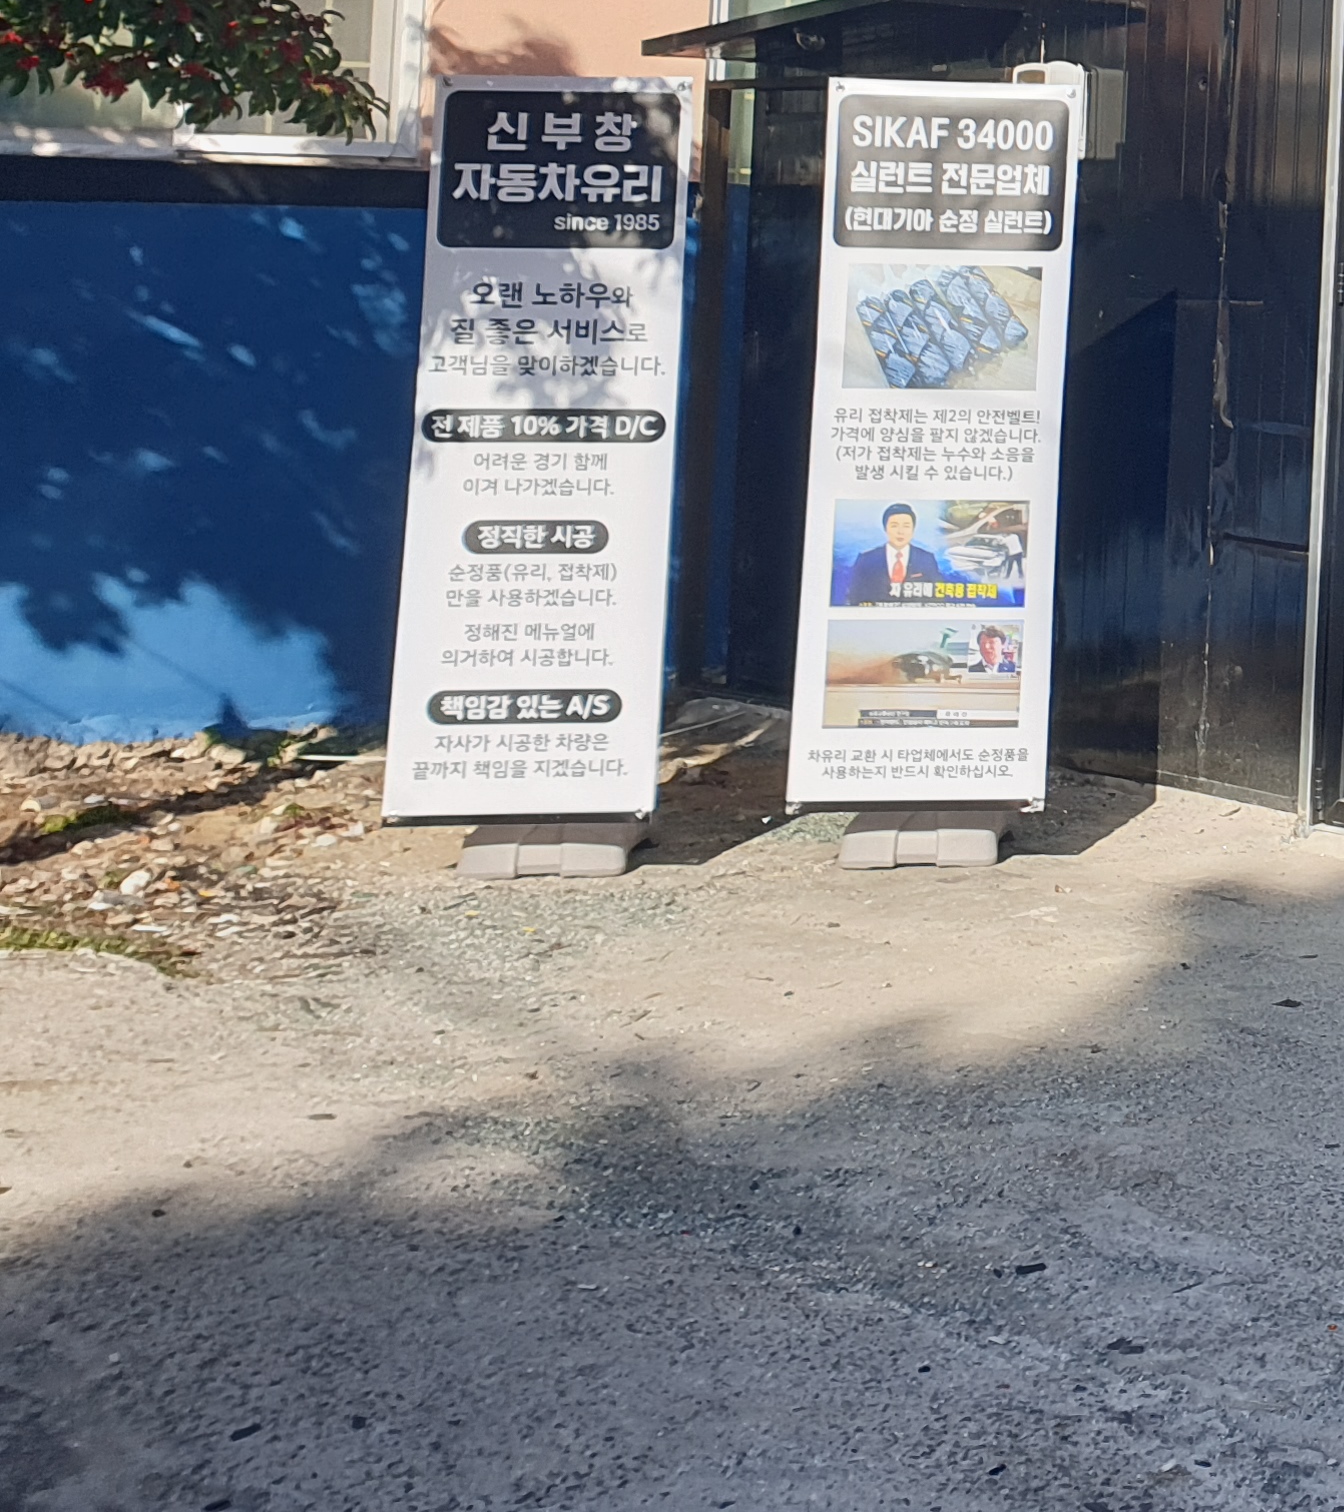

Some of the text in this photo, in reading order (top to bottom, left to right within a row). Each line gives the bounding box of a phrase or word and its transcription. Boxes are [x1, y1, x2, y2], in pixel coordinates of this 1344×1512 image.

[852, 114, 1054, 152] SIKAF 34000
[452, 162, 663, 203] 자동차유리
[850, 161, 1050, 197] 실런트 전문업체
[554, 213, 660, 232] since 1985
[844, 206, 1052, 236] (현대기아 순정 실런트)
[470, 282, 634, 309] 오랜 노하우와
[450, 318, 648, 345] 질 좋은 서비스로
[428, 354, 666, 376] 고객님을 맞이하겠습니다.
[511, 415, 559, 436] 10%
[565, 414, 608, 439] 가격
[614, 415, 659, 439] D/C
[833, 408, 1041, 425] 유리 접착제는 제2의 안전벨트!
[831, 427, 875, 443] 가격에
[880, 427, 923, 444] 양심을
[930, 428, 959, 444] 팔지
[473, 452, 608, 471] 어려운 경기 함께
[835, 446, 1035, 464] (저가 접착제는 누수와 소음을
[462, 478, 497, 496] 이겨
[476, 524, 595, 551] 정직한 시공
[445, 589, 482, 608] 만을
[464, 623, 518, 642] 정해진
[441, 648, 514, 668] 의거하여
[439, 694, 611, 722] 책임감 있는 A/S
[434, 734, 610, 754] 자사가 시공한 차량은
[807, 749, 846, 763] 차유리
[411, 760, 467, 780] 끝까지
[472, 760, 528, 779] 책임을
[822, 765, 887, 779] 사용하는지
[891, 765, 929, 779] 반드시
